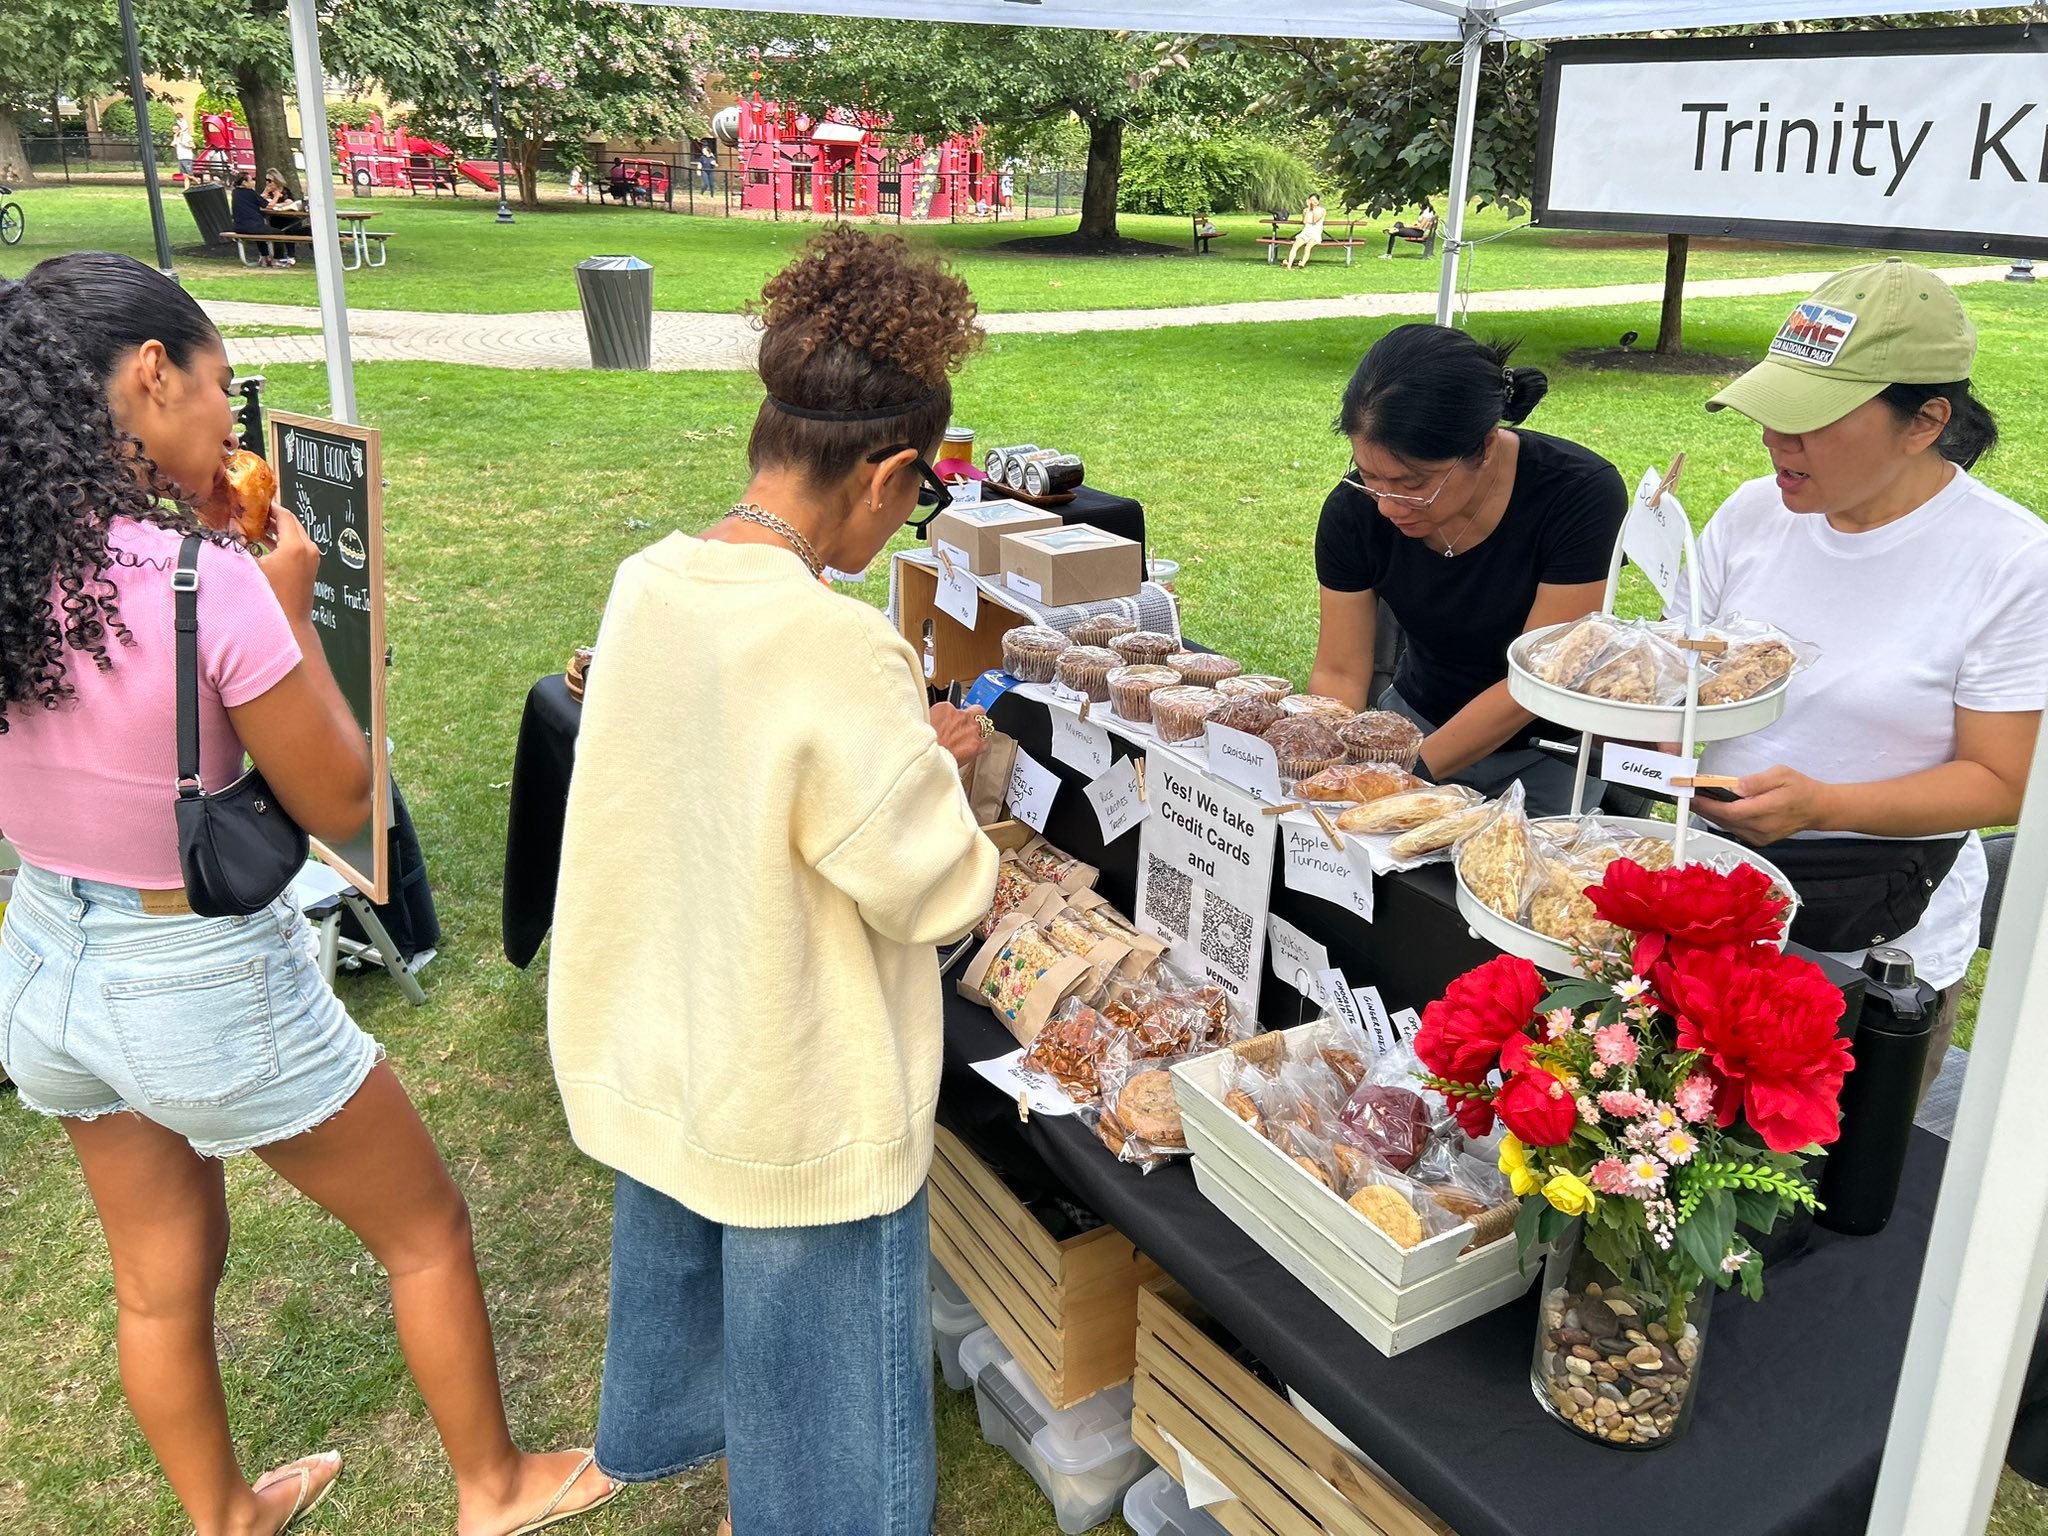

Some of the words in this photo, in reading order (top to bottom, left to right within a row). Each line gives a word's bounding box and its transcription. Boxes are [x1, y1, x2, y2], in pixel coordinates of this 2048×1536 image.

[1681, 102, 1934, 197] Trinity
[1780, 341, 1809, 357] NATIONAL
[1809, 349, 1832, 362] PARK
[324, 444, 352, 483] GOODS
[305, 505, 333, 548] Pies!
[343, 584, 361, 610] Fruit
[1065, 722, 1093, 745] MUFFINS
[1221, 743, 1264, 767] CROISSANT
[1621, 761, 1663, 780] GINGER
[1127, 778, 1138, 792] $5
[1249, 787, 1262, 800] $5
[1026, 811, 1038, 823] $7
[1163, 772, 1192, 802] Yes!
[1197, 790, 1219, 817] We
[1222, 807, 1255, 837] take
[1161, 802, 1203, 839] Credit
[1207, 828, 1251, 866] Cards
[1290, 832, 1329, 853] Apple
[1188, 852, 1215, 877] and
[1290, 849, 1351, 878] Turnover
[1352, 891, 1365, 911] $5
[1272, 924, 1310, 961] Cookies
[1205, 966, 1239, 995] venmo
[1333, 990, 1346, 1014] CHIP
[1335, 980, 1357, 1025] CHOCOLATE
